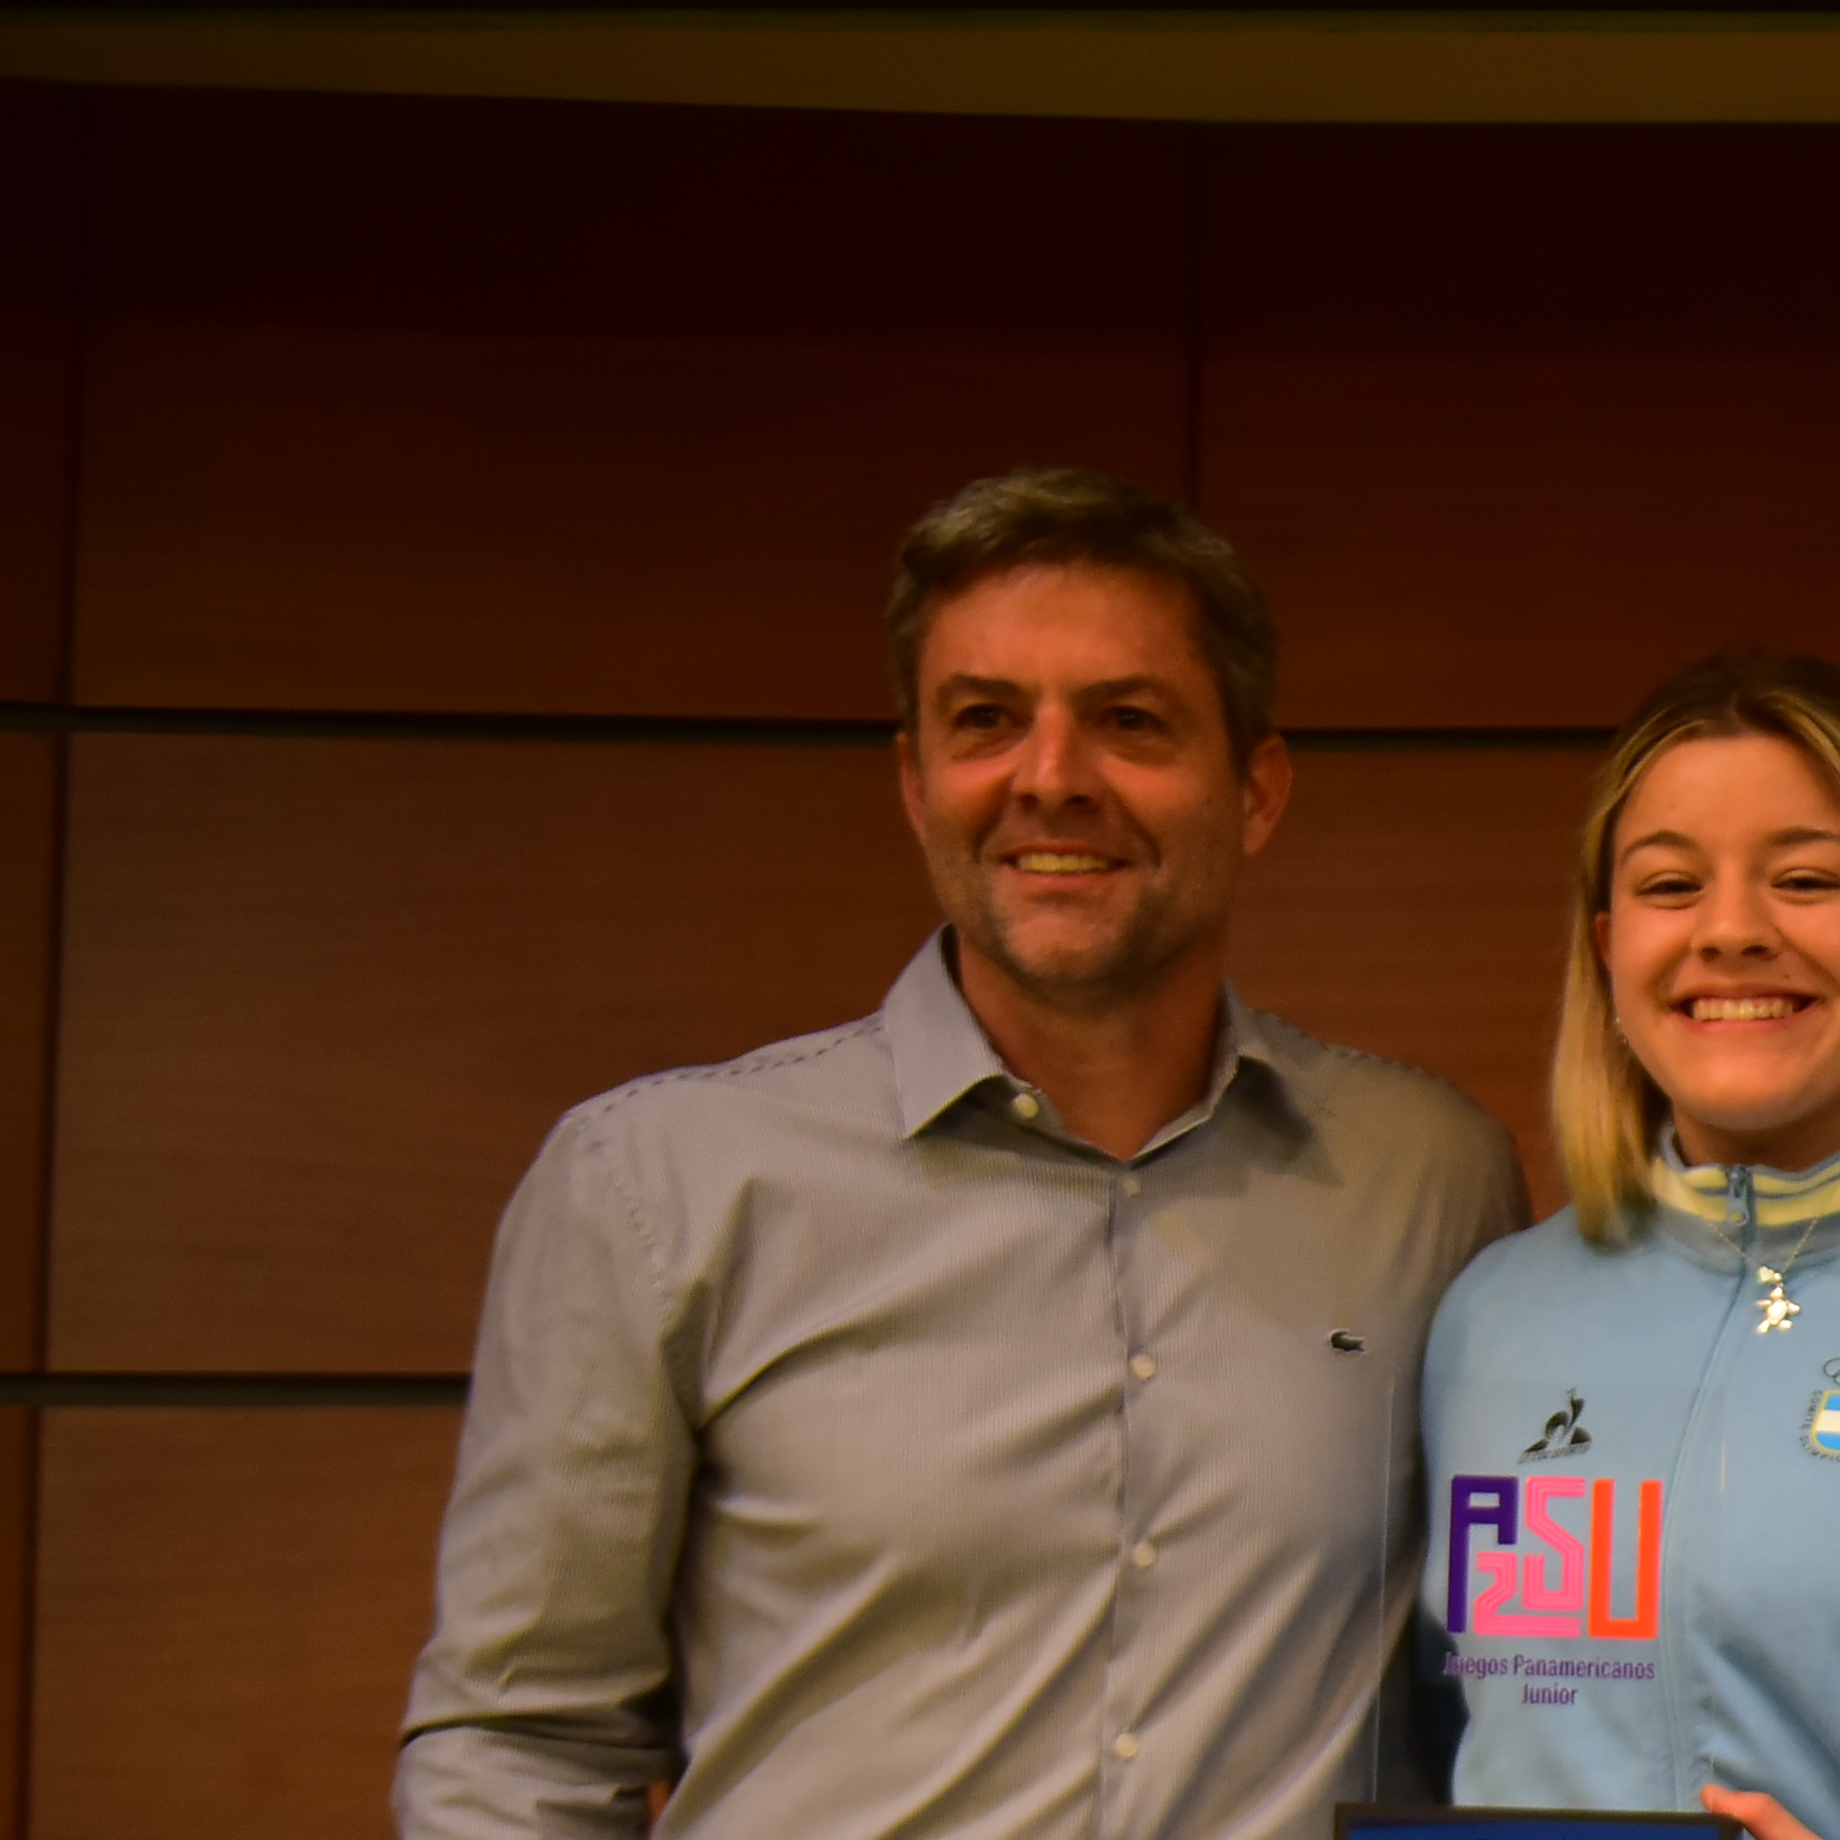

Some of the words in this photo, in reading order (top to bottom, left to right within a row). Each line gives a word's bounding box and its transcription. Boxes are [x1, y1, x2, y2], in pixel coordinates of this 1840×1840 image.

[1444, 1653, 1508, 1680] Juegos
[1514, 1654, 1656, 1681] Panamericanos
[1522, 1682, 1578, 1706] Junior
